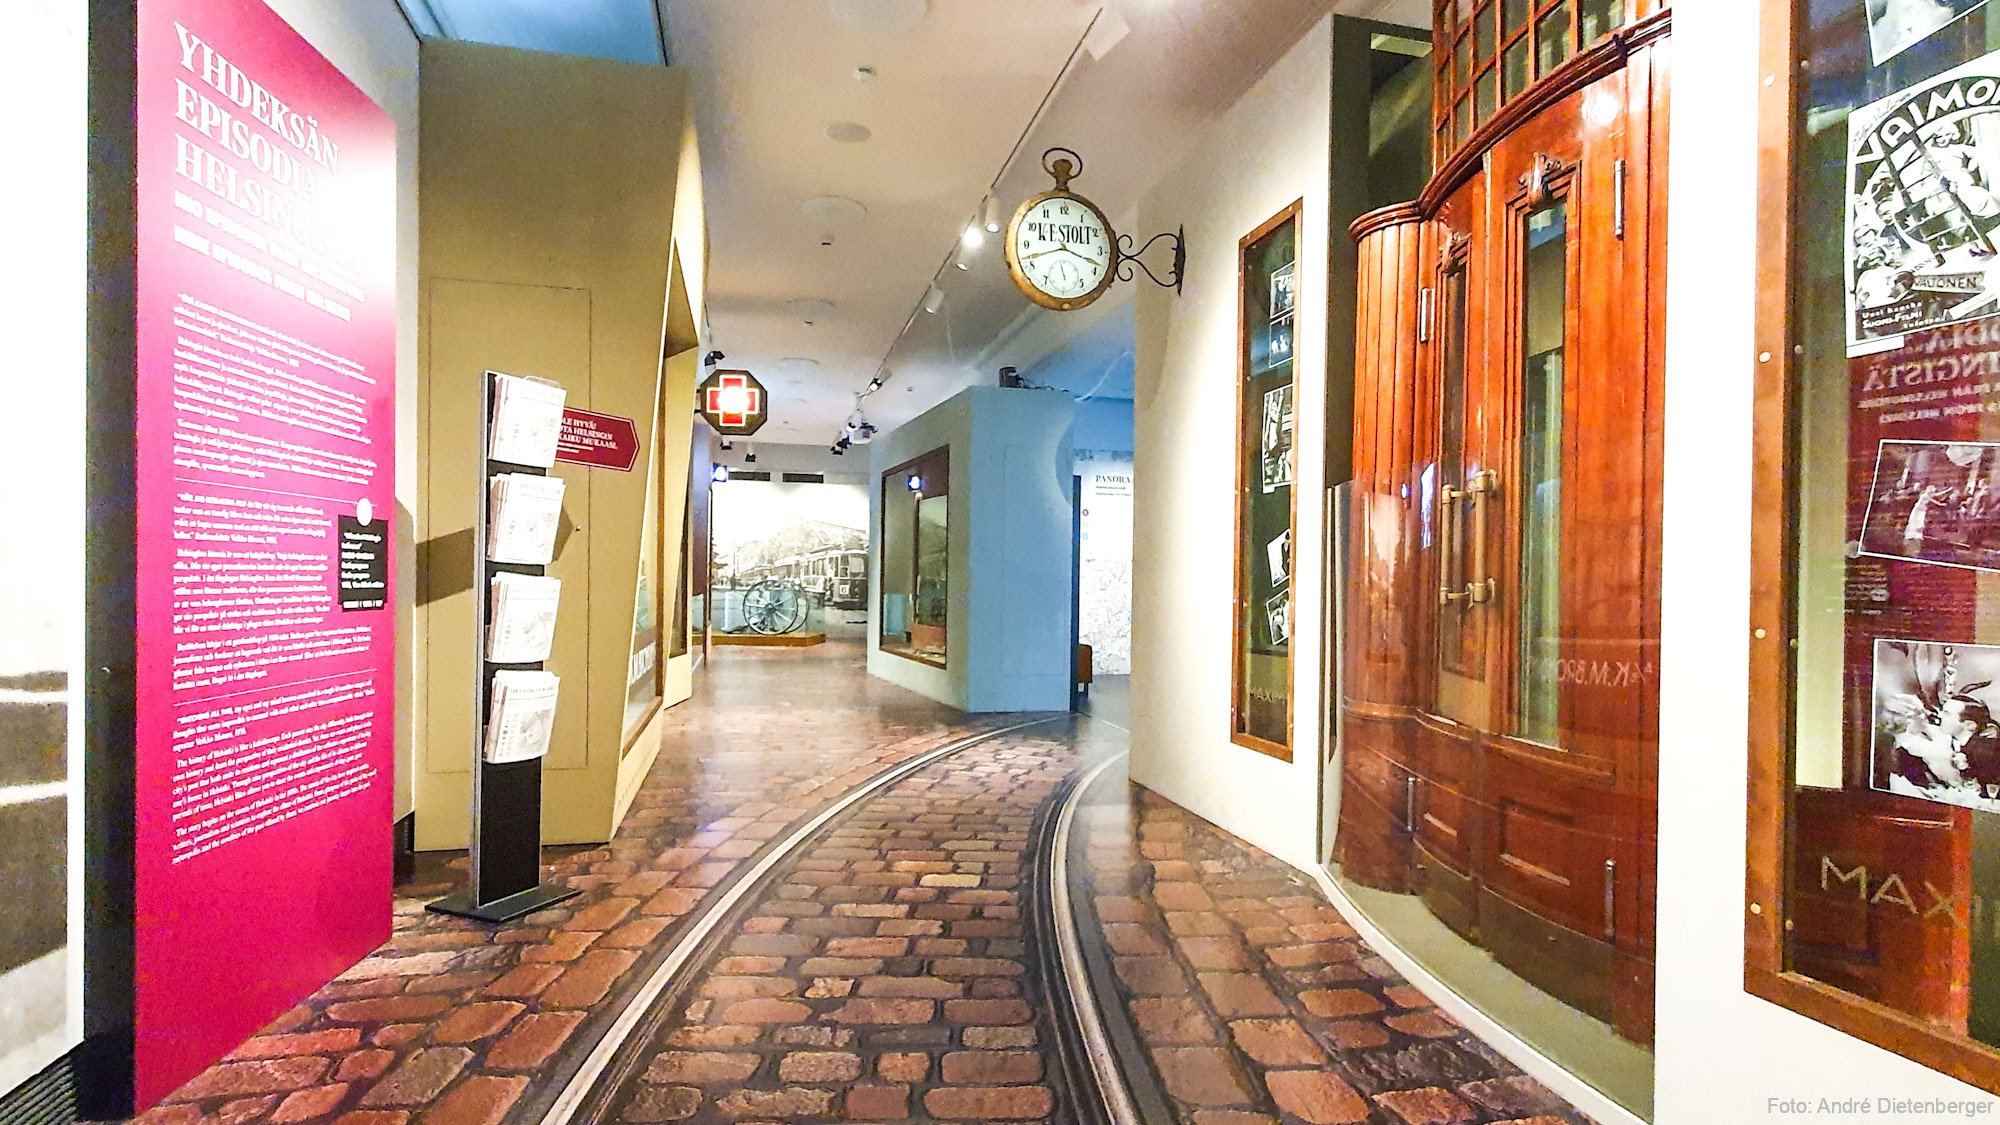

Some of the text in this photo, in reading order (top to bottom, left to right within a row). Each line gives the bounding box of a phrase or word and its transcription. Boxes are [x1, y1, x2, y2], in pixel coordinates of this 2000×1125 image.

[174, 20, 341, 176] YHDEKSÄN
[174, 77, 319, 203] EPISODIA
[1043, 208, 1050, 219] 11
[1060, 205, 1069, 215] 12
[1080, 214, 1084, 223] 1
[1028, 222, 1037, 232] 10
[1092, 227, 1099, 237] 2
[1023, 240, 1030, 249] 9
[1097, 245, 1104, 256] 3
[1091, 266, 1097, 276] 4
[1043, 274, 1048, 285] 7
[1079, 278, 1084, 288] 5
[562, 417, 573, 426] LE
[1095, 475, 1131, 484] PANORA
